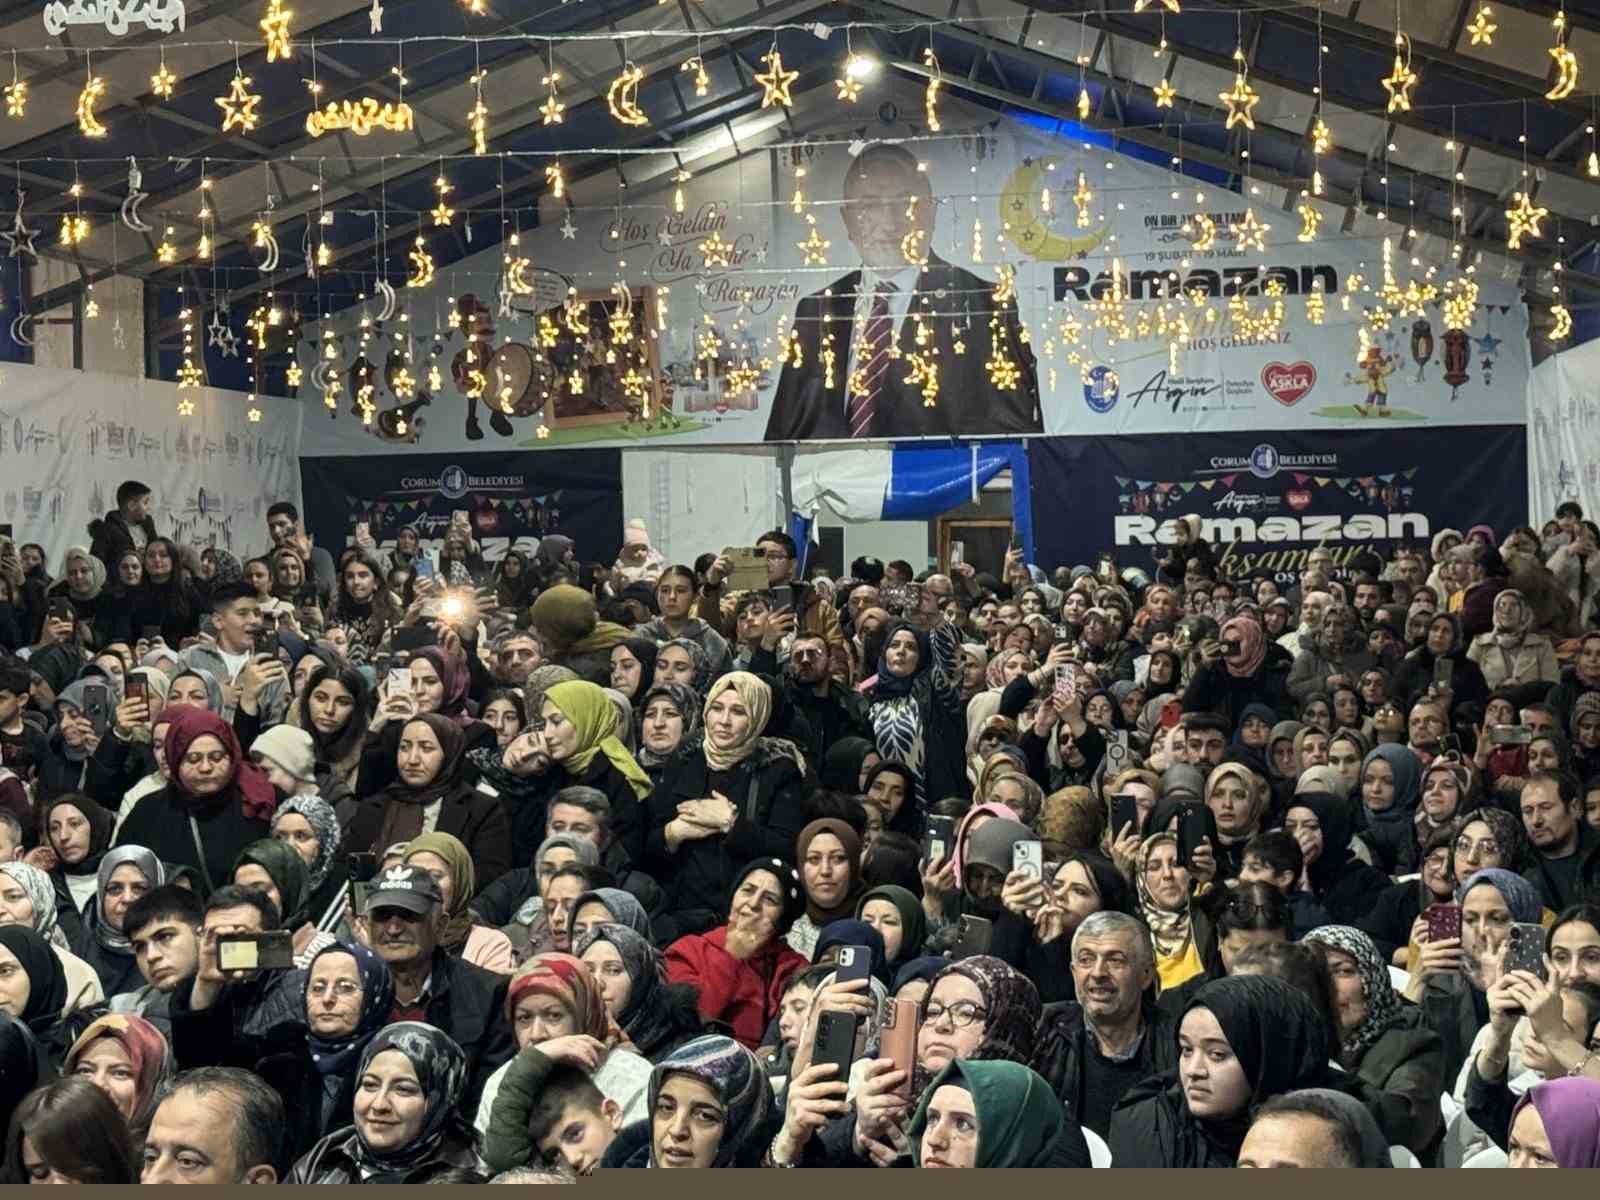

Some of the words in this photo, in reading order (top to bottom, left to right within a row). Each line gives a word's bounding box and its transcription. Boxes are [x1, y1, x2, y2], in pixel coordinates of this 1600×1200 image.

[1054, 265, 1337, 302] Ramazan
[1210, 456, 1250, 469] ÇORUM
[1279, 453, 1337, 466] BELEDİYESİ
[380, 881, 412, 890] adidas
